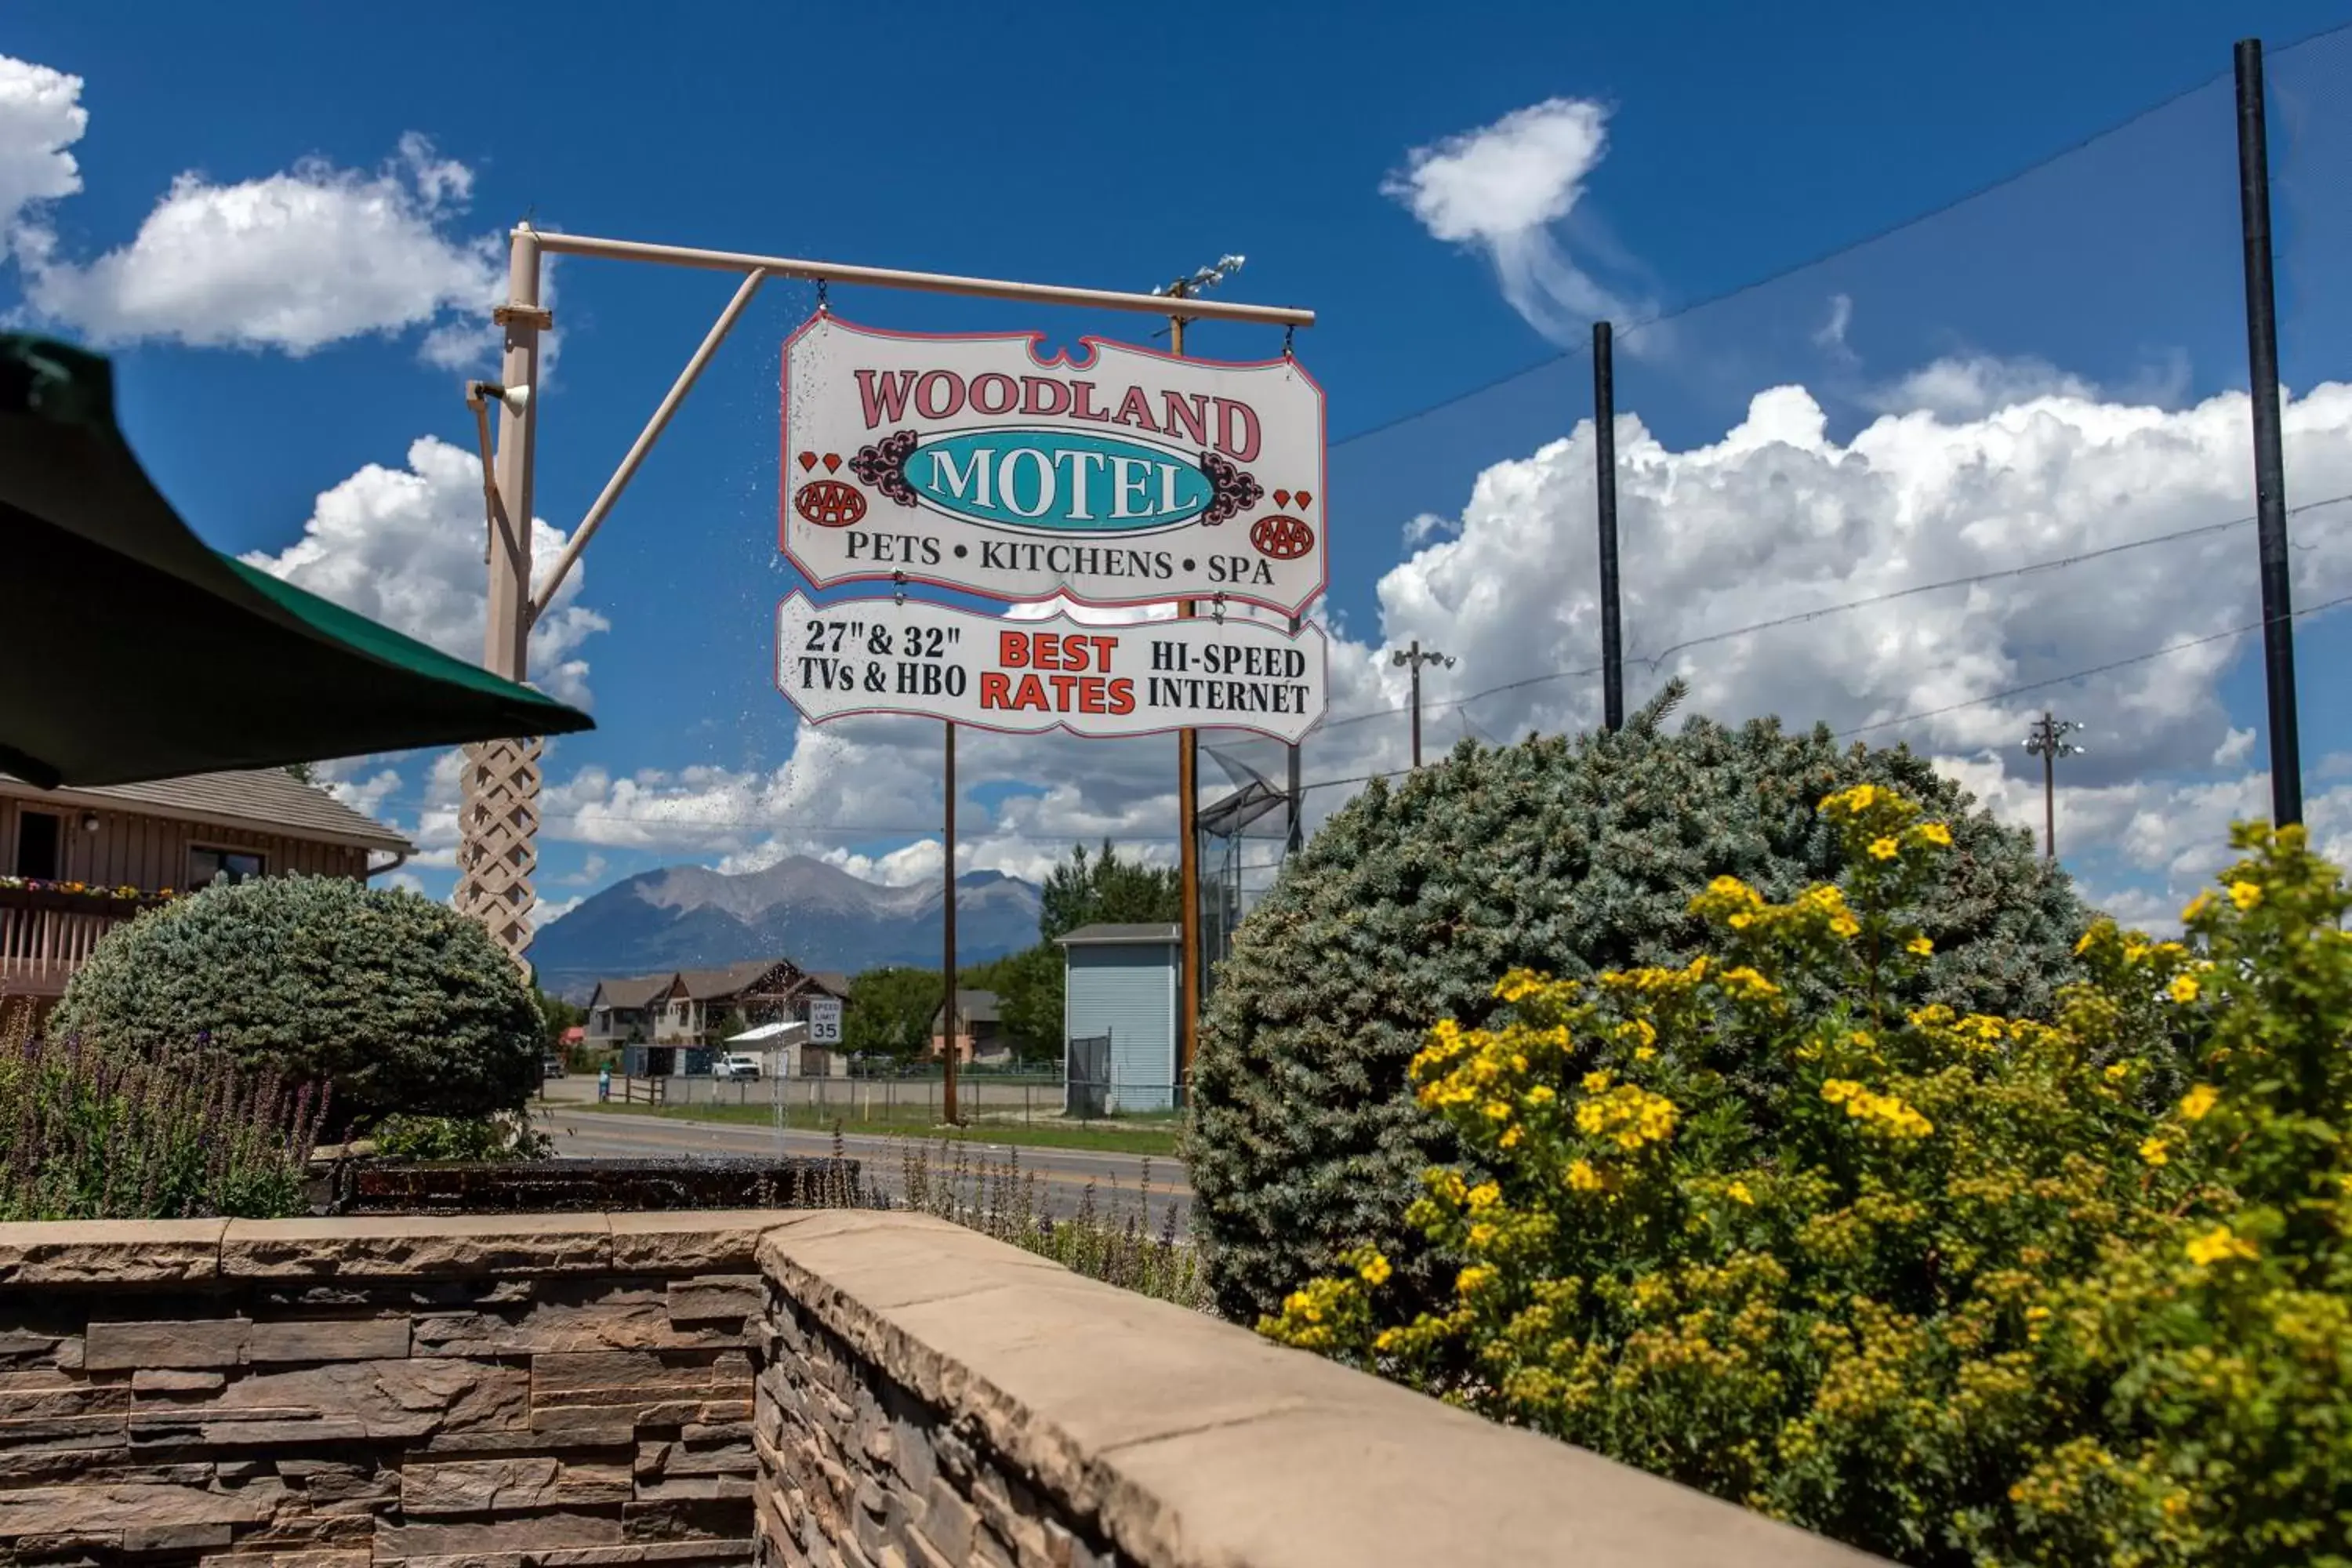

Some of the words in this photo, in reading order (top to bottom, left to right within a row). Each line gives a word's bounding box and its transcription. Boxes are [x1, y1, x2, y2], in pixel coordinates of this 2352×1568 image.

[855, 369, 1261, 463] WOODLAND
[797, 480, 866, 527] AAA
[927, 448, 1199, 520] MOTEL
[845, 531, 941, 565] PETS
[979, 540, 1173, 579] KITCHENS
[1207, 555, 1276, 586] SPA
[1250, 515, 1314, 560] AAA
[805, 620, 863, 652] 27"
[867, 624, 893, 655] &
[903, 626, 960, 658] 32"
[1000, 630, 1119, 673] BEST
[1150, 641, 1306, 679] HI-SPEED
[797, 657, 855, 691] TVs
[863, 661, 887, 692] &
[896, 662, 967, 697] HBO
[980, 671, 1136, 716] RATES
[1147, 677, 1311, 715] INTERNET
[814, 1023, 837, 1038] 35
